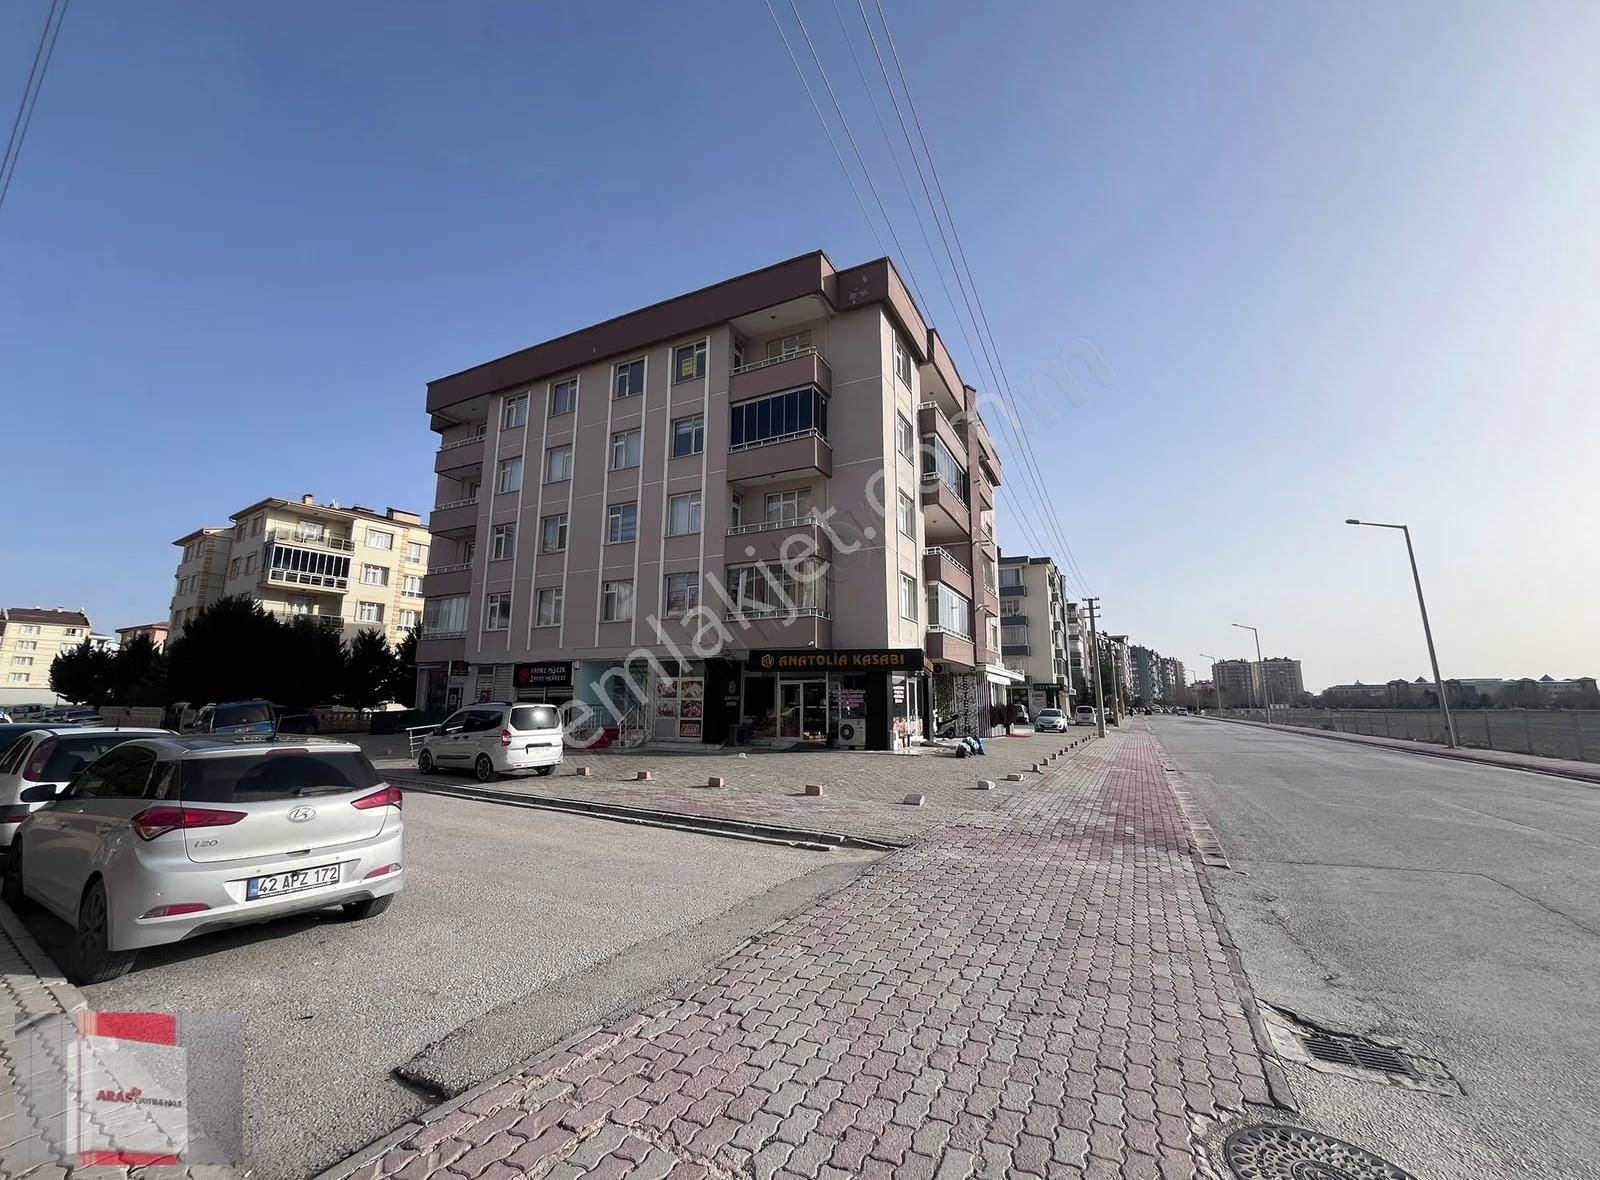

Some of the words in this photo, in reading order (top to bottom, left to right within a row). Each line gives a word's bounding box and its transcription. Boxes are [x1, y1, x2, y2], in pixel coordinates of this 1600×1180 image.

[852, 654, 905, 667] KASABI
[259, 878, 278, 893] 42
[282, 872, 309, 889] APZ
[314, 867, 337, 882] 172
